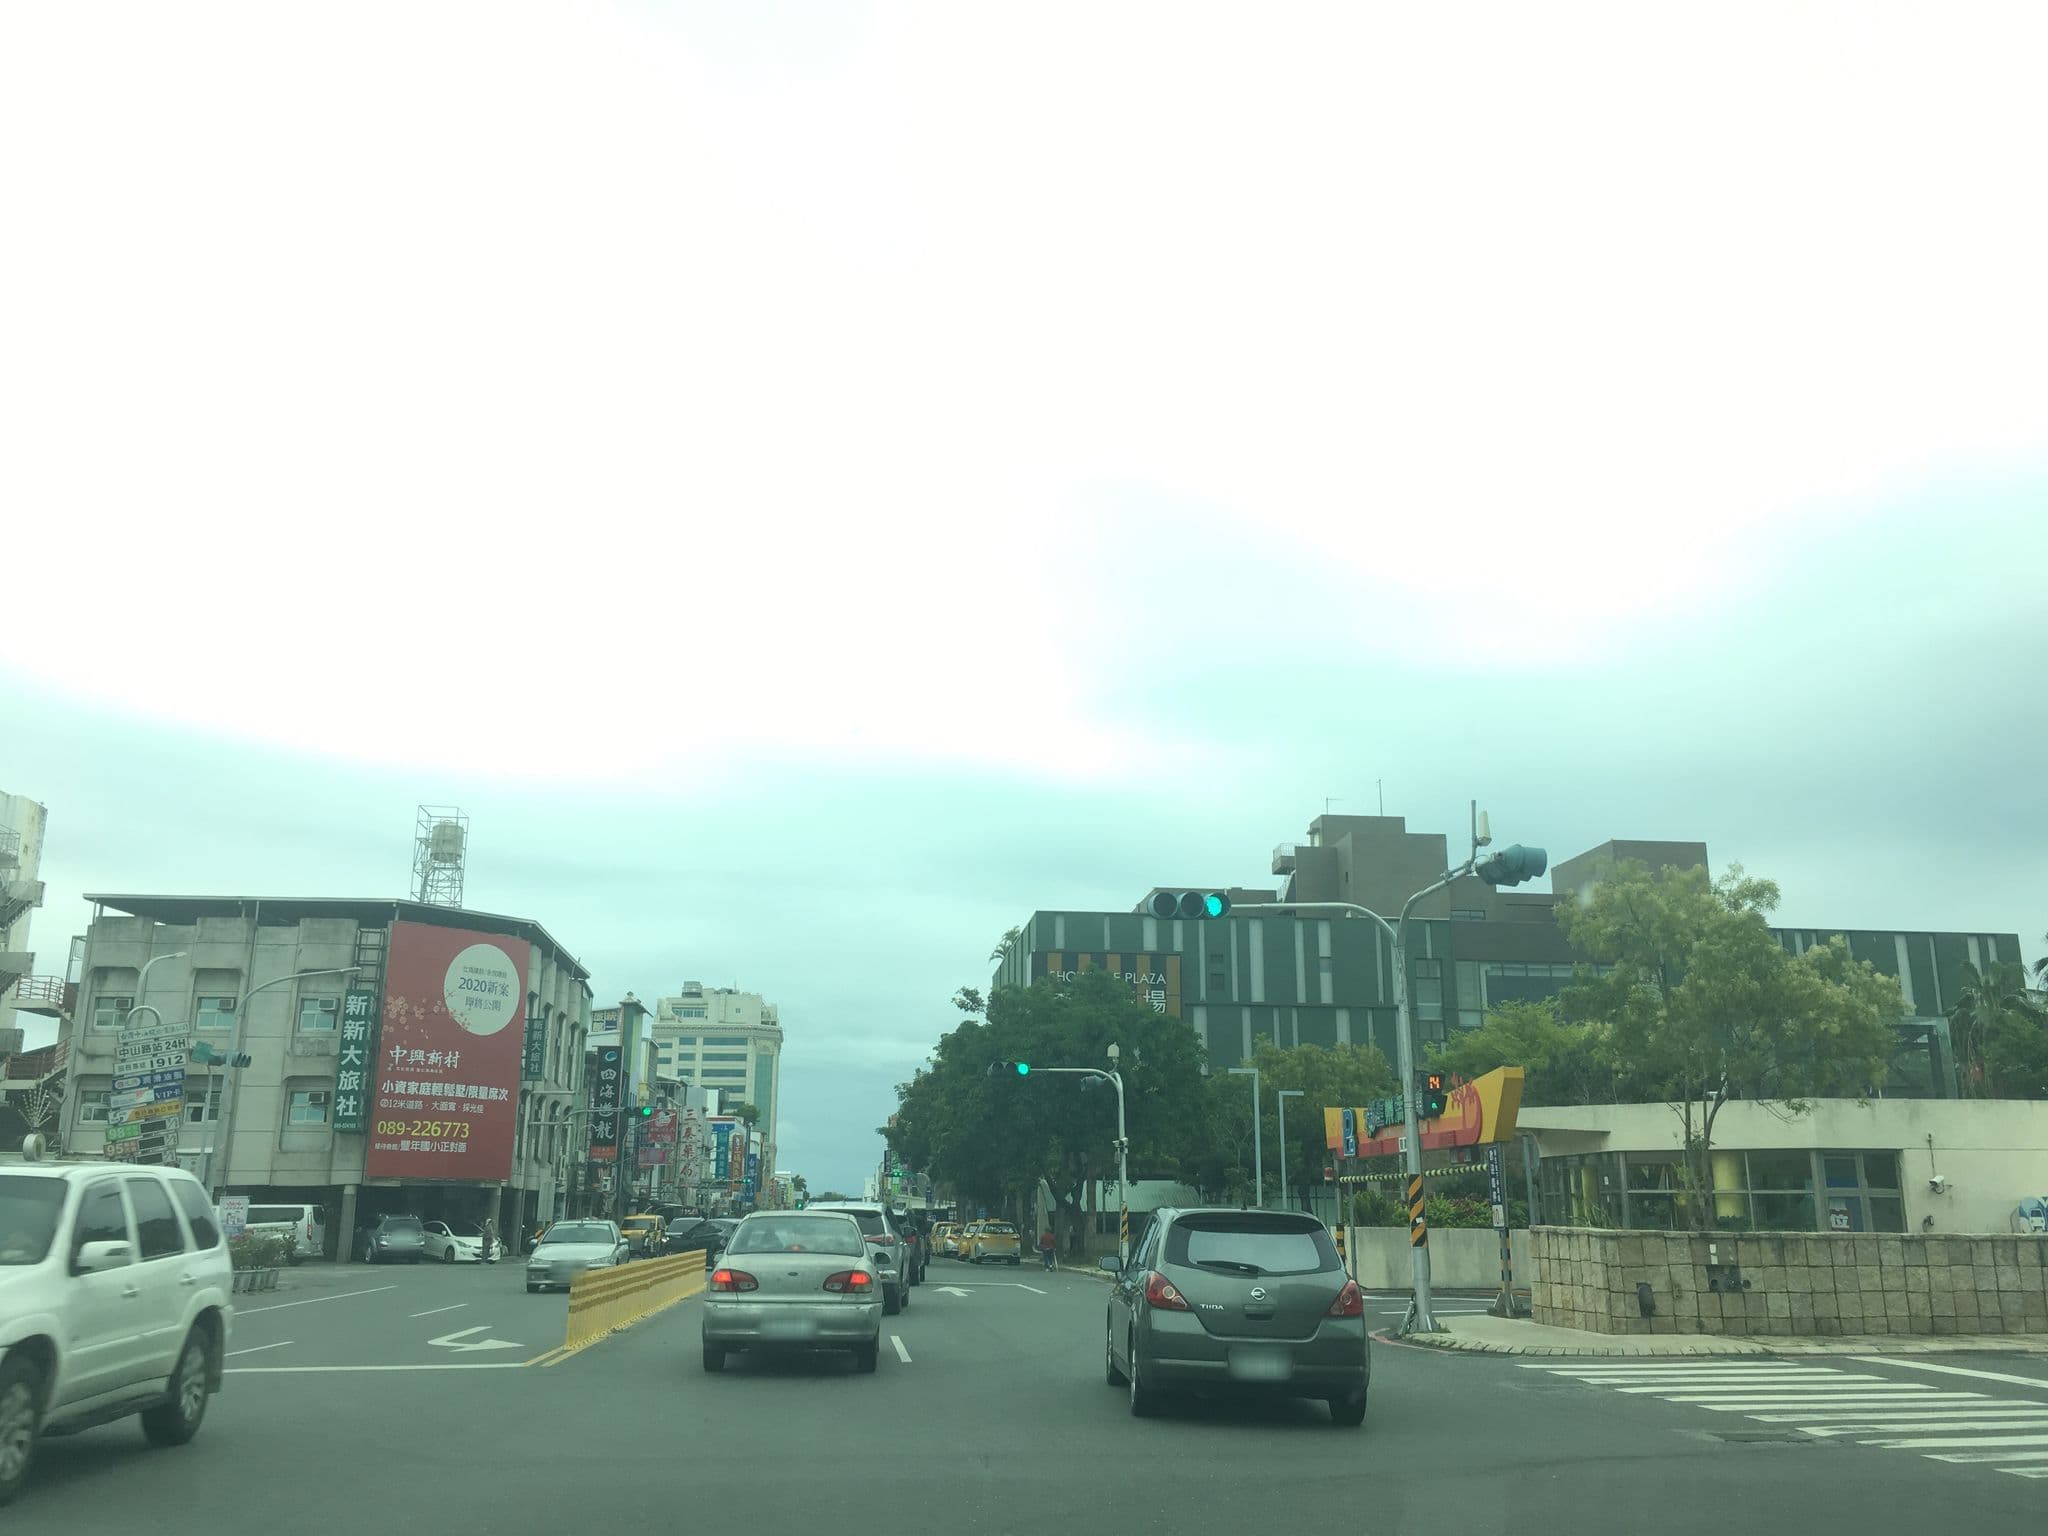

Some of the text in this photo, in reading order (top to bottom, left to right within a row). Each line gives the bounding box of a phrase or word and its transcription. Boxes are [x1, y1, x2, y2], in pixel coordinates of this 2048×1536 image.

[458, 977, 510, 997] 2020新案
[1124, 972, 1167, 985] PLAZA
[119, 1038, 187, 1058] 中山路站 24H
[335, 994, 368, 1116] 新新大旅社
[389, 1045, 460, 1069] 中興新村
[149, 1055, 184, 1069] 1912
[377, 1120, 470, 1138] 089-226773
[106, 1141, 125, 1156] 95
